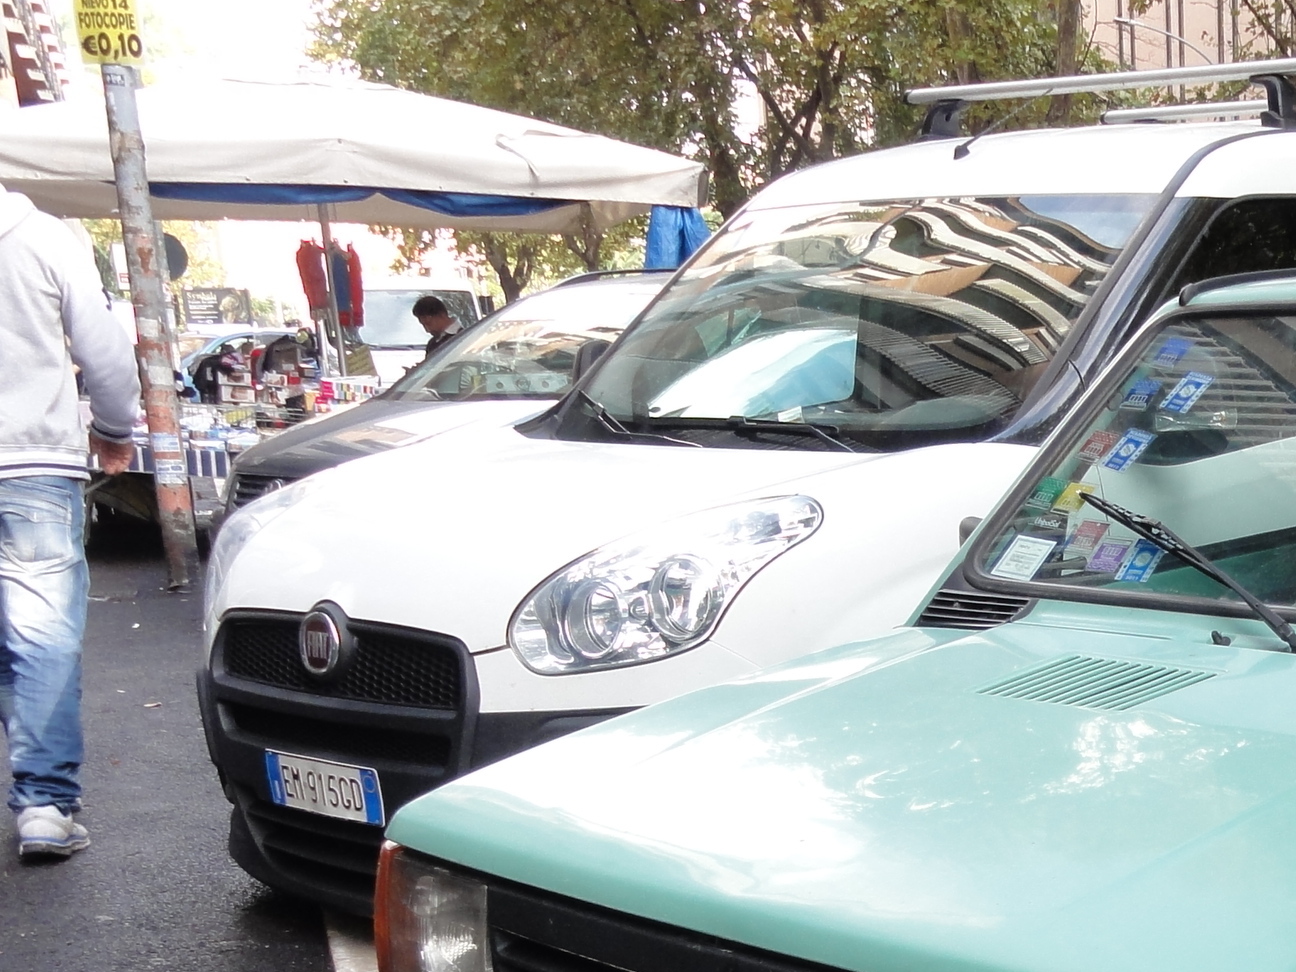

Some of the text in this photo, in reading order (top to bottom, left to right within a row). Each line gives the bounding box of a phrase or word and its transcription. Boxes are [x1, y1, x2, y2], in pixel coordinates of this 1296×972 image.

[78, 12, 136, 30] FOTOCOPIE
[82, 32, 142, 60] €0,10
[307, 630, 329, 659] FIAT
[281, 765, 306, 800] EM
[306, 771, 364, 811] 915GD
